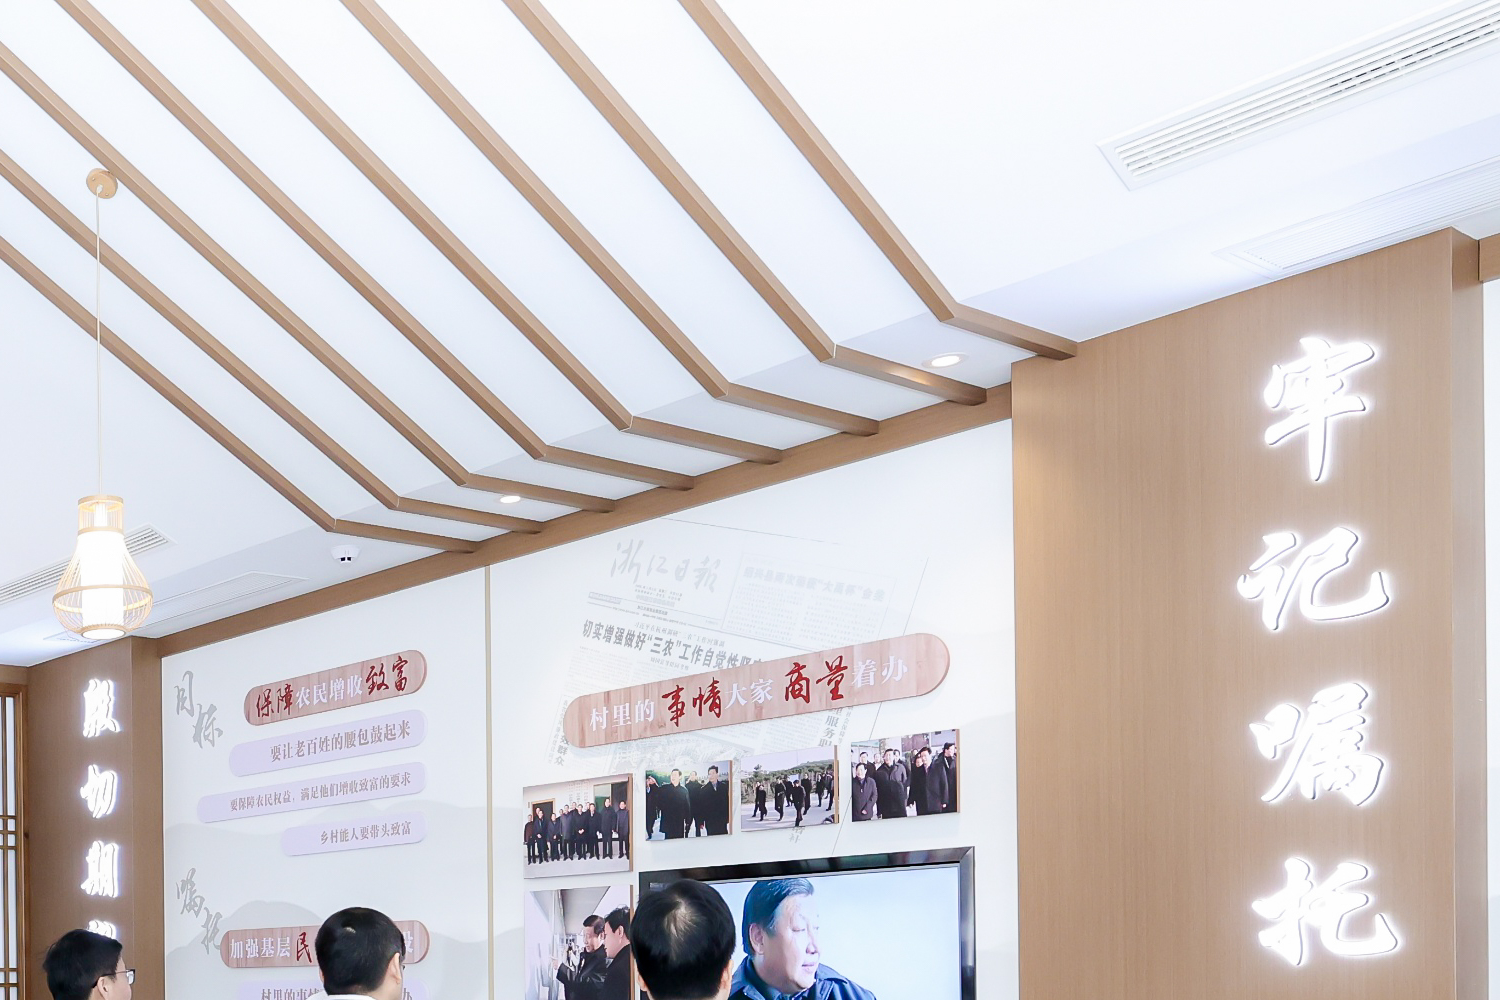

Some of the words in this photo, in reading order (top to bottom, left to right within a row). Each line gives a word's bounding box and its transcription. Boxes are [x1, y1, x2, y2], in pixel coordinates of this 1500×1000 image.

[1237, 337, 1398, 966] 牢记嘱托
[256, 655, 408, 718] 保障农民增收致富
[589, 654, 909, 728] 村里的事情大家商量着办
[269, 719, 411, 763] 要让老百姓的腰包鼓起来
[230, 771, 411, 812] 要保障农民权益，满足他们增收致富的要求
[320, 820, 412, 845] 乡村能人要带头致富
